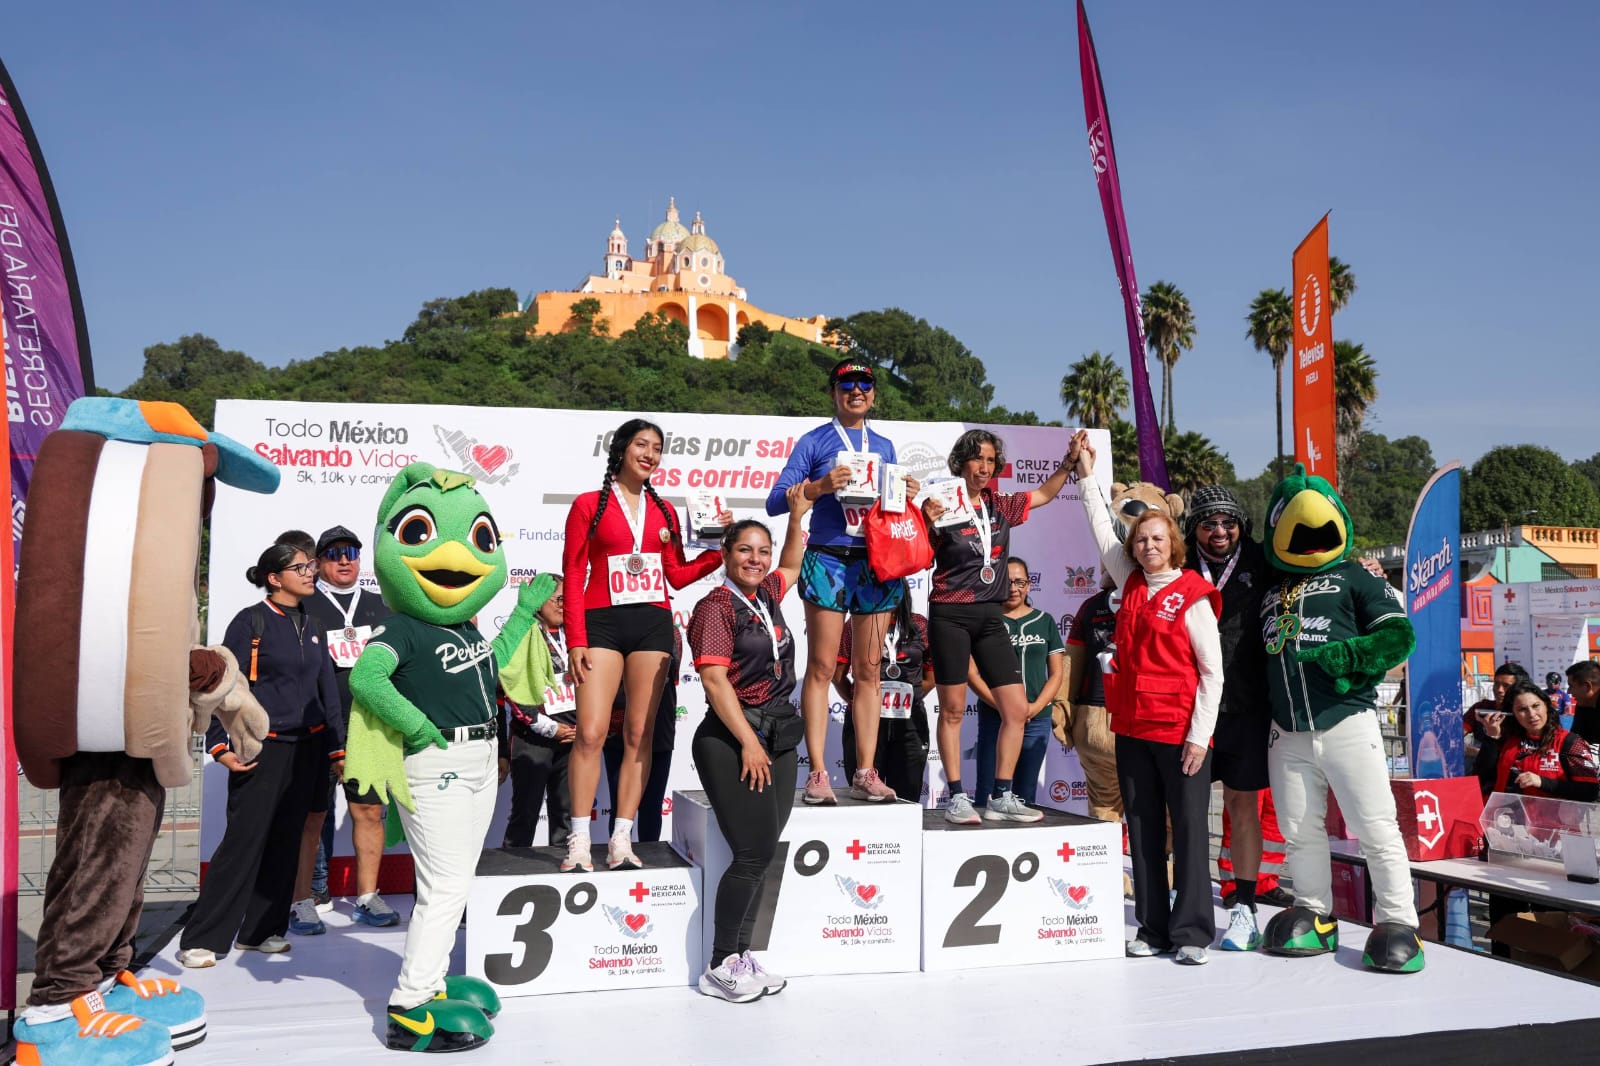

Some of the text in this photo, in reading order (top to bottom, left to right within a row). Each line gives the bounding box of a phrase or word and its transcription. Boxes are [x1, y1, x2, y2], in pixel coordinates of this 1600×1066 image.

[1299, 341, 1325, 370] Televisa
[265, 418, 408, 444] Todo México
[253, 443, 419, 468] Salvando Vidas
[705, 437, 751, 461] por
[1016, 459, 1050, 471] CRUZ
[510, 568, 537, 576] GRAN
[611, 568, 663, 593] 0852
[651, 890, 686, 898] MEXICANA
[827, 913, 888, 925] Todo México
[1041, 913, 1098, 926] Todo México
[822, 926, 893, 938] Salvando Vidas
[1037, 926, 1103, 939] Salvando Vidas
[593, 942, 658, 956] Todo México
[588, 955, 663, 969] Salvando Vidas
